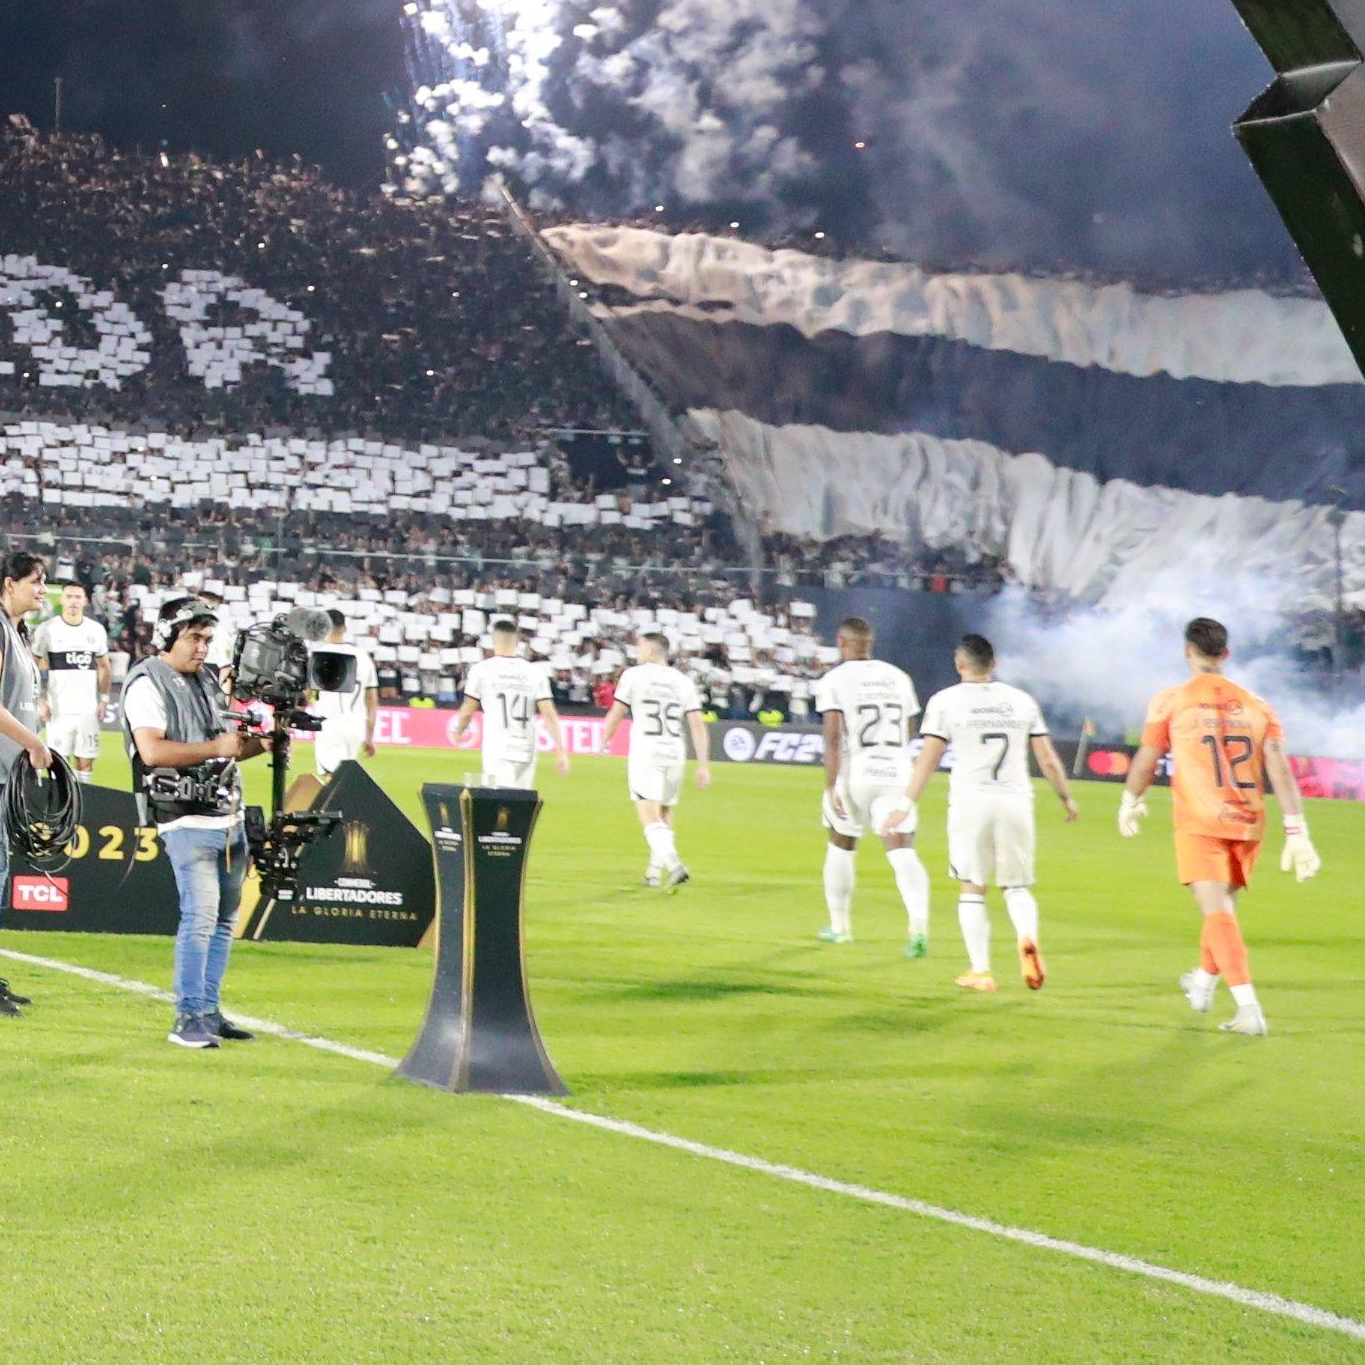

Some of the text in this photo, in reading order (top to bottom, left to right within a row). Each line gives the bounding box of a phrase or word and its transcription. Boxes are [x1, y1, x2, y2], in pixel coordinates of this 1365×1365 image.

[496, 692, 530, 729] 14
[856, 702, 903, 748] 23
[980, 732, 1009, 781] 7
[1200, 734, 1256, 789] 12
[17, 884, 64, 904] TCL
[305, 886, 403, 906] LIBERTADORES
[291, 905, 418, 921] LA GLORIA ETERNA
